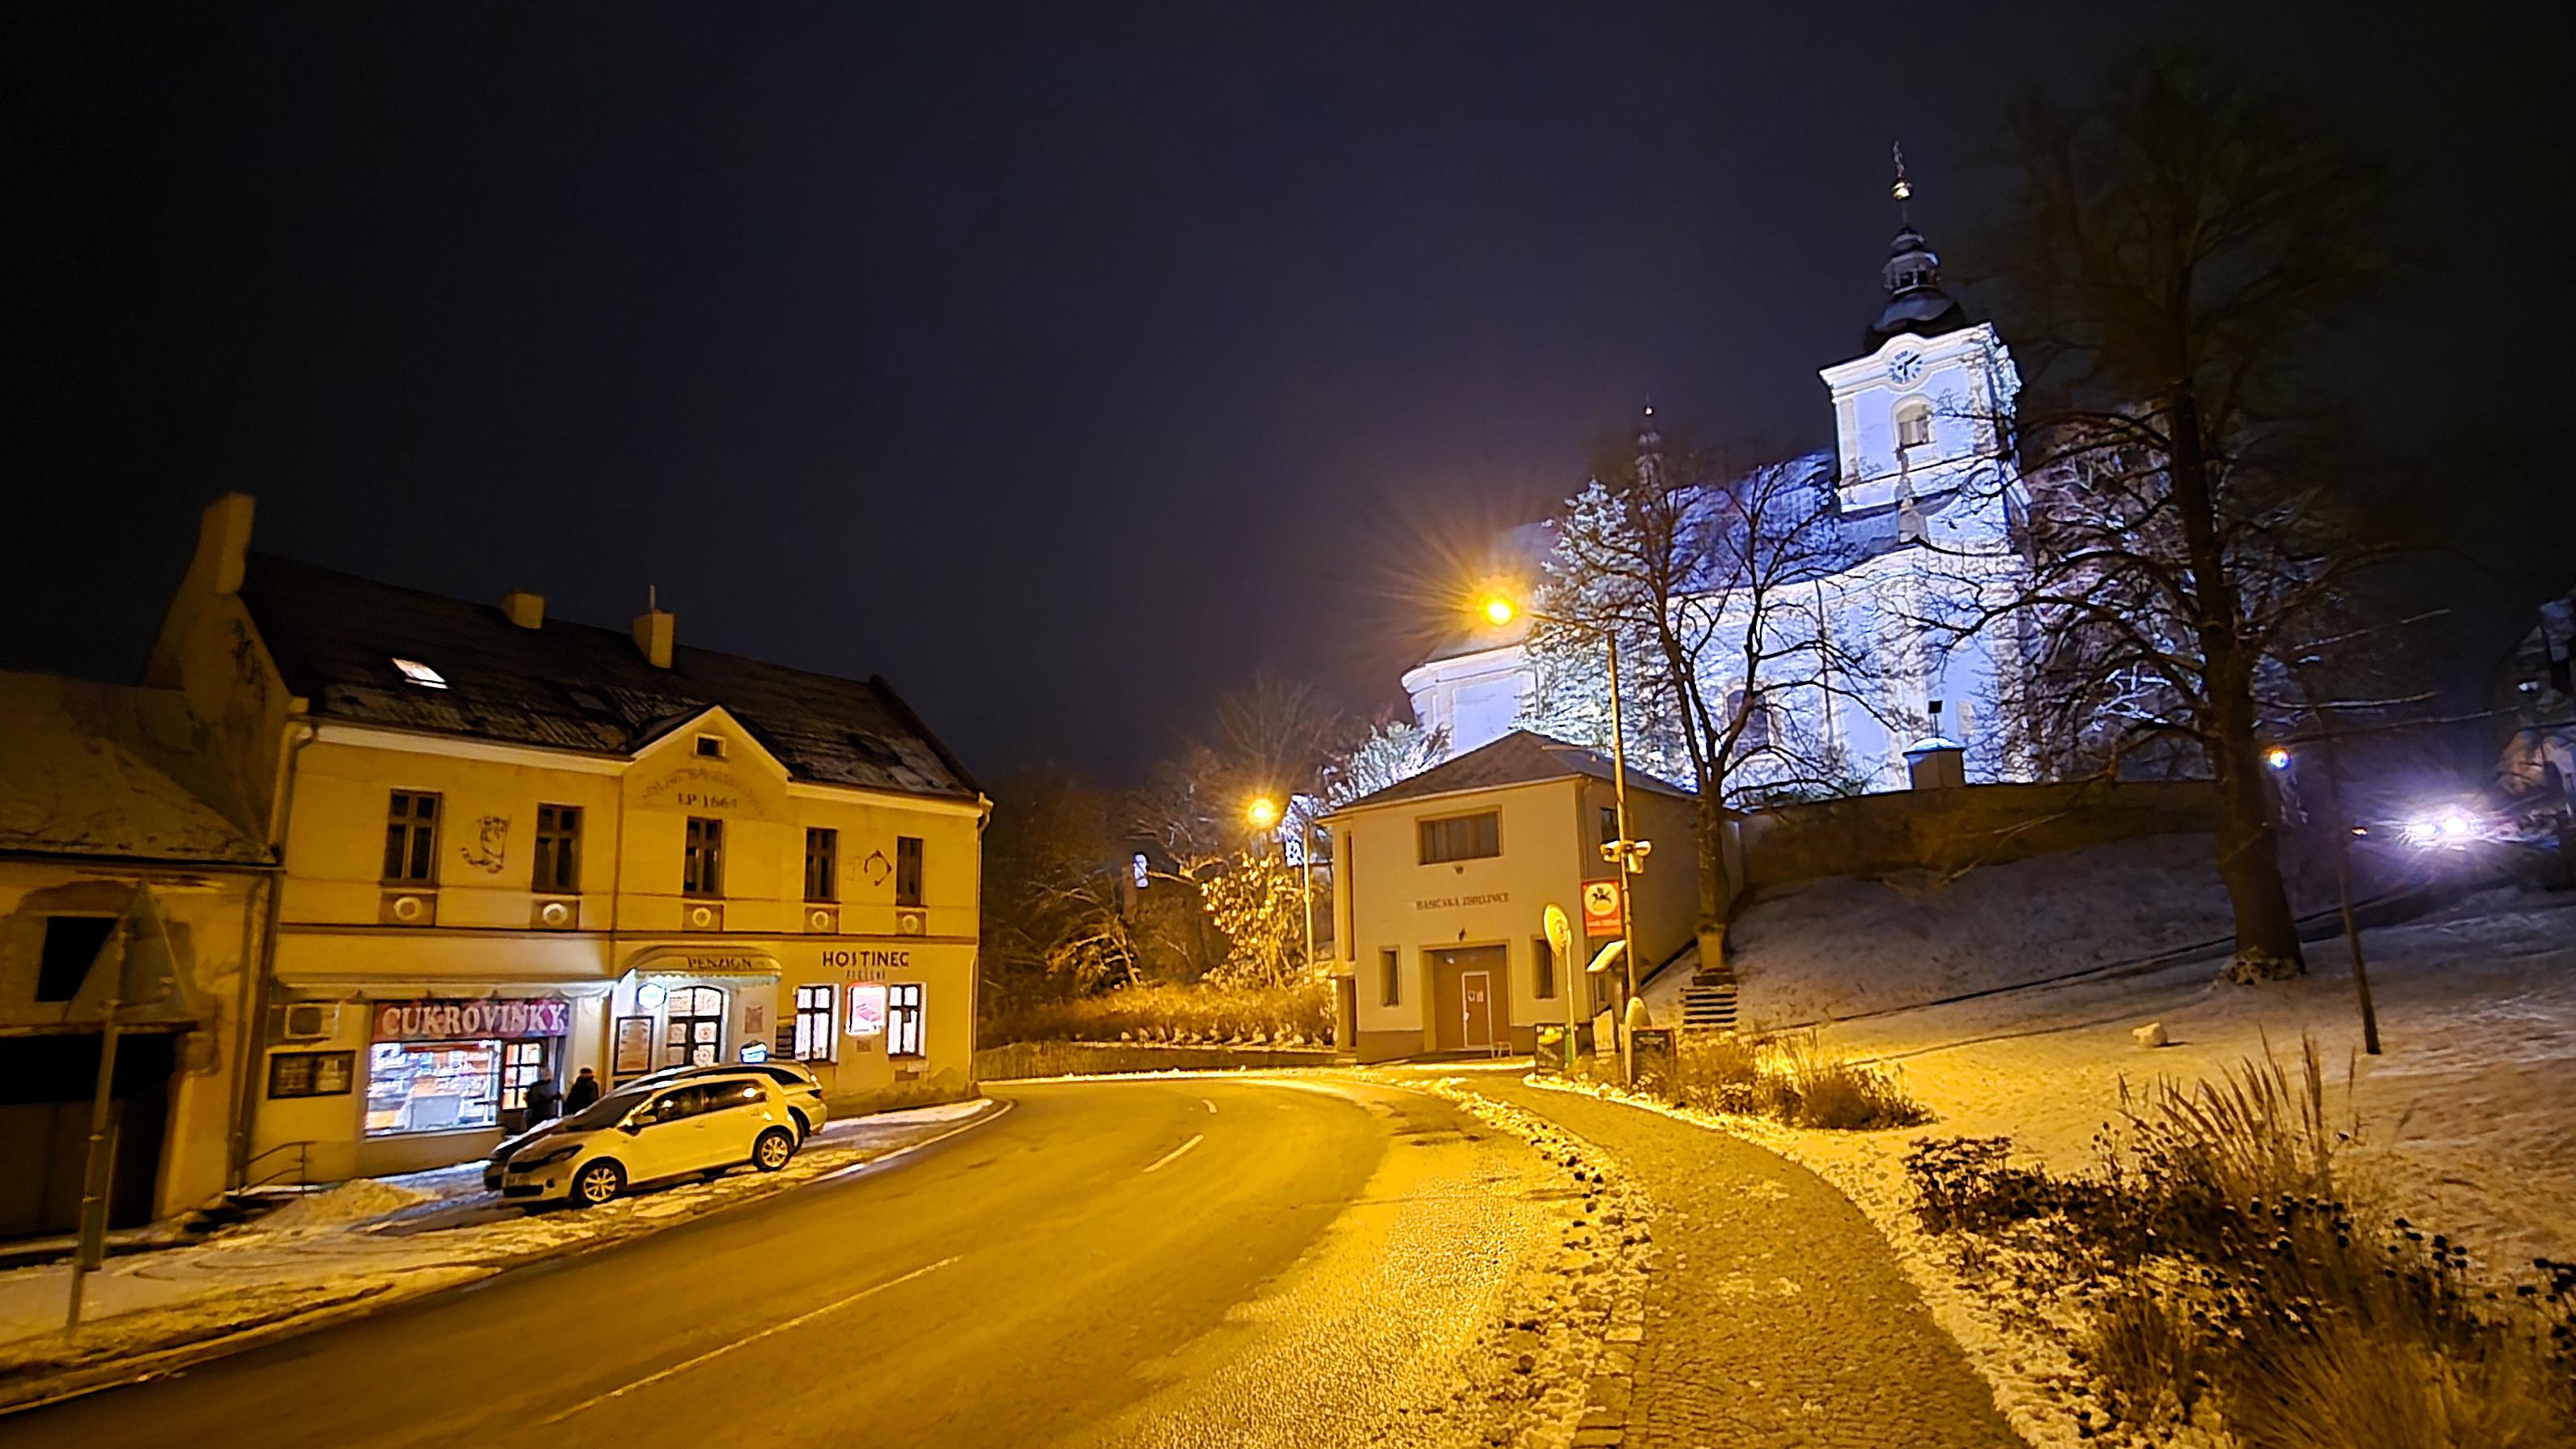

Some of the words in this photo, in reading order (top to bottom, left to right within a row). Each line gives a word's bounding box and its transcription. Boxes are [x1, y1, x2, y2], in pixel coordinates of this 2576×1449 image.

[688, 957, 752, 970] PENZION
[823, 951, 911, 967] HOSTINEC
[382, 1004, 566, 1035] CUKROVINKY
